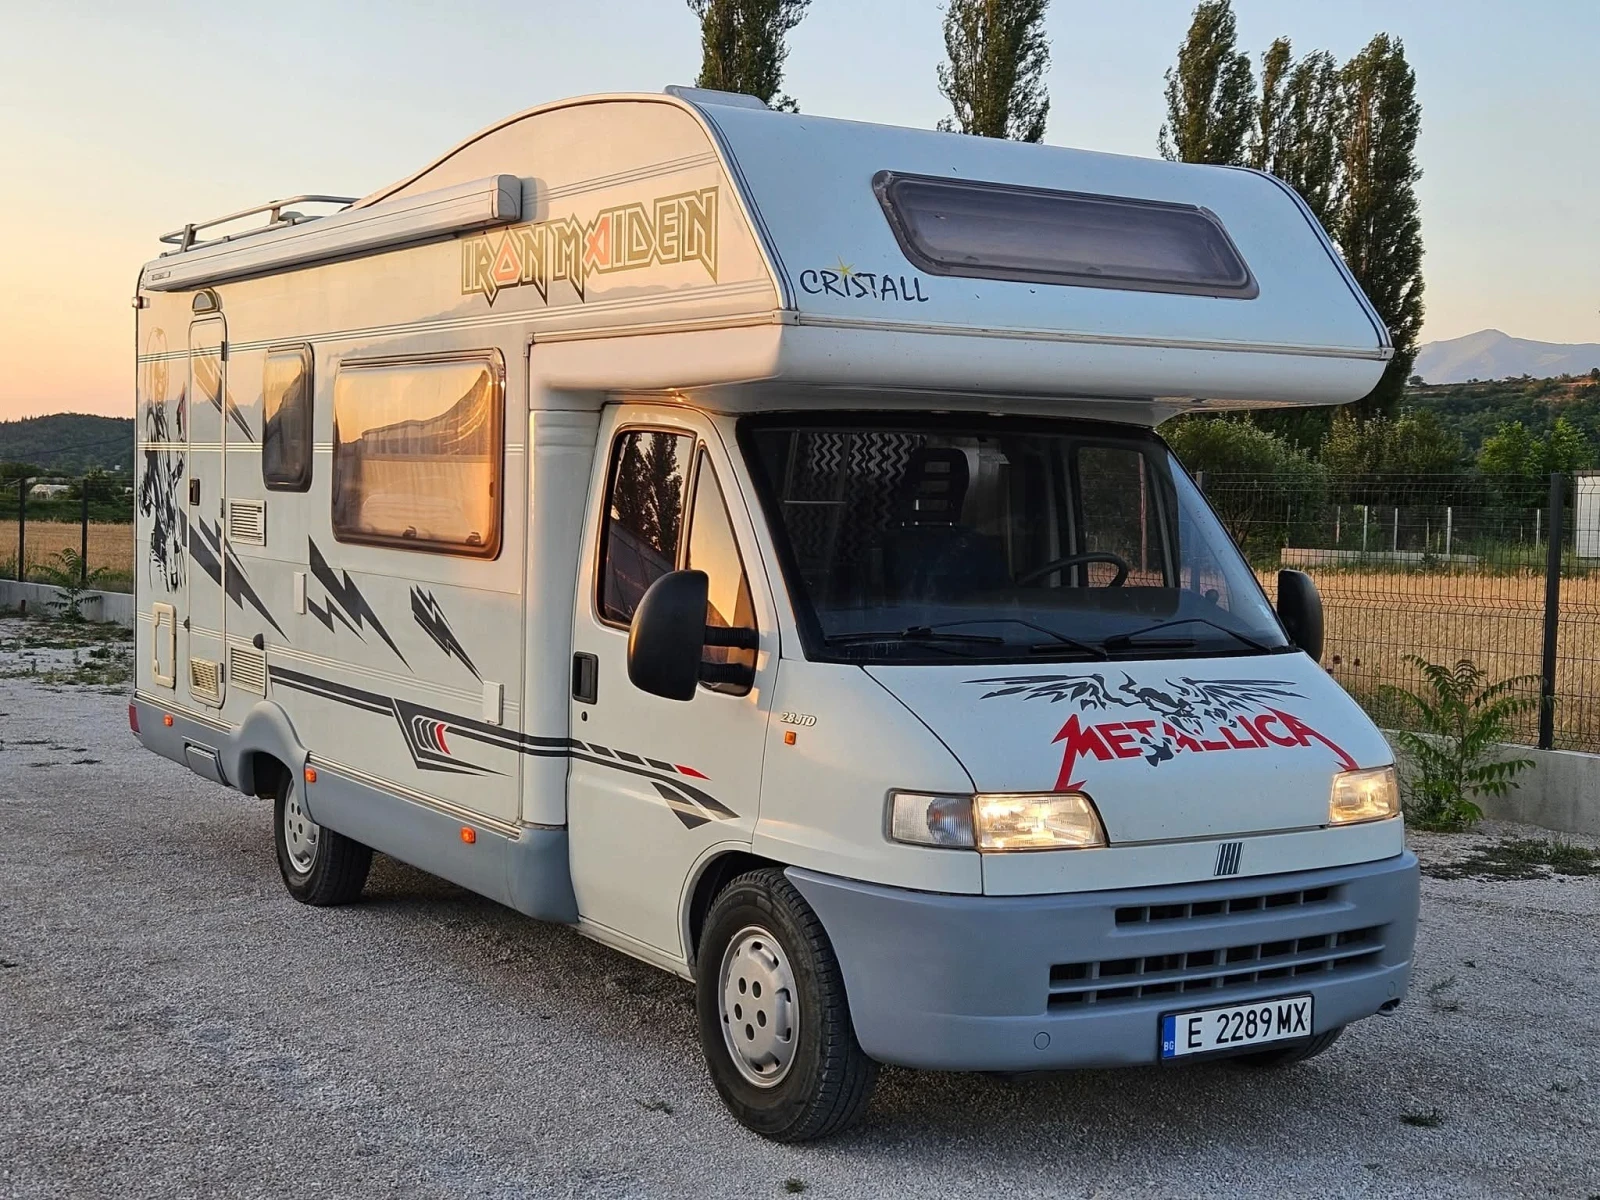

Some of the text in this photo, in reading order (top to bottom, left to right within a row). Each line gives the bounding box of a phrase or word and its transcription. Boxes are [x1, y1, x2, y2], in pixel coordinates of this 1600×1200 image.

[461, 186, 719, 308] IRON MAIDEN
[800, 269, 929, 302] CRISTALL
[1051, 704, 1360, 792] METALLICA
[1163, 1040, 1174, 1051] BG
[1188, 1017, 1203, 1048] E
